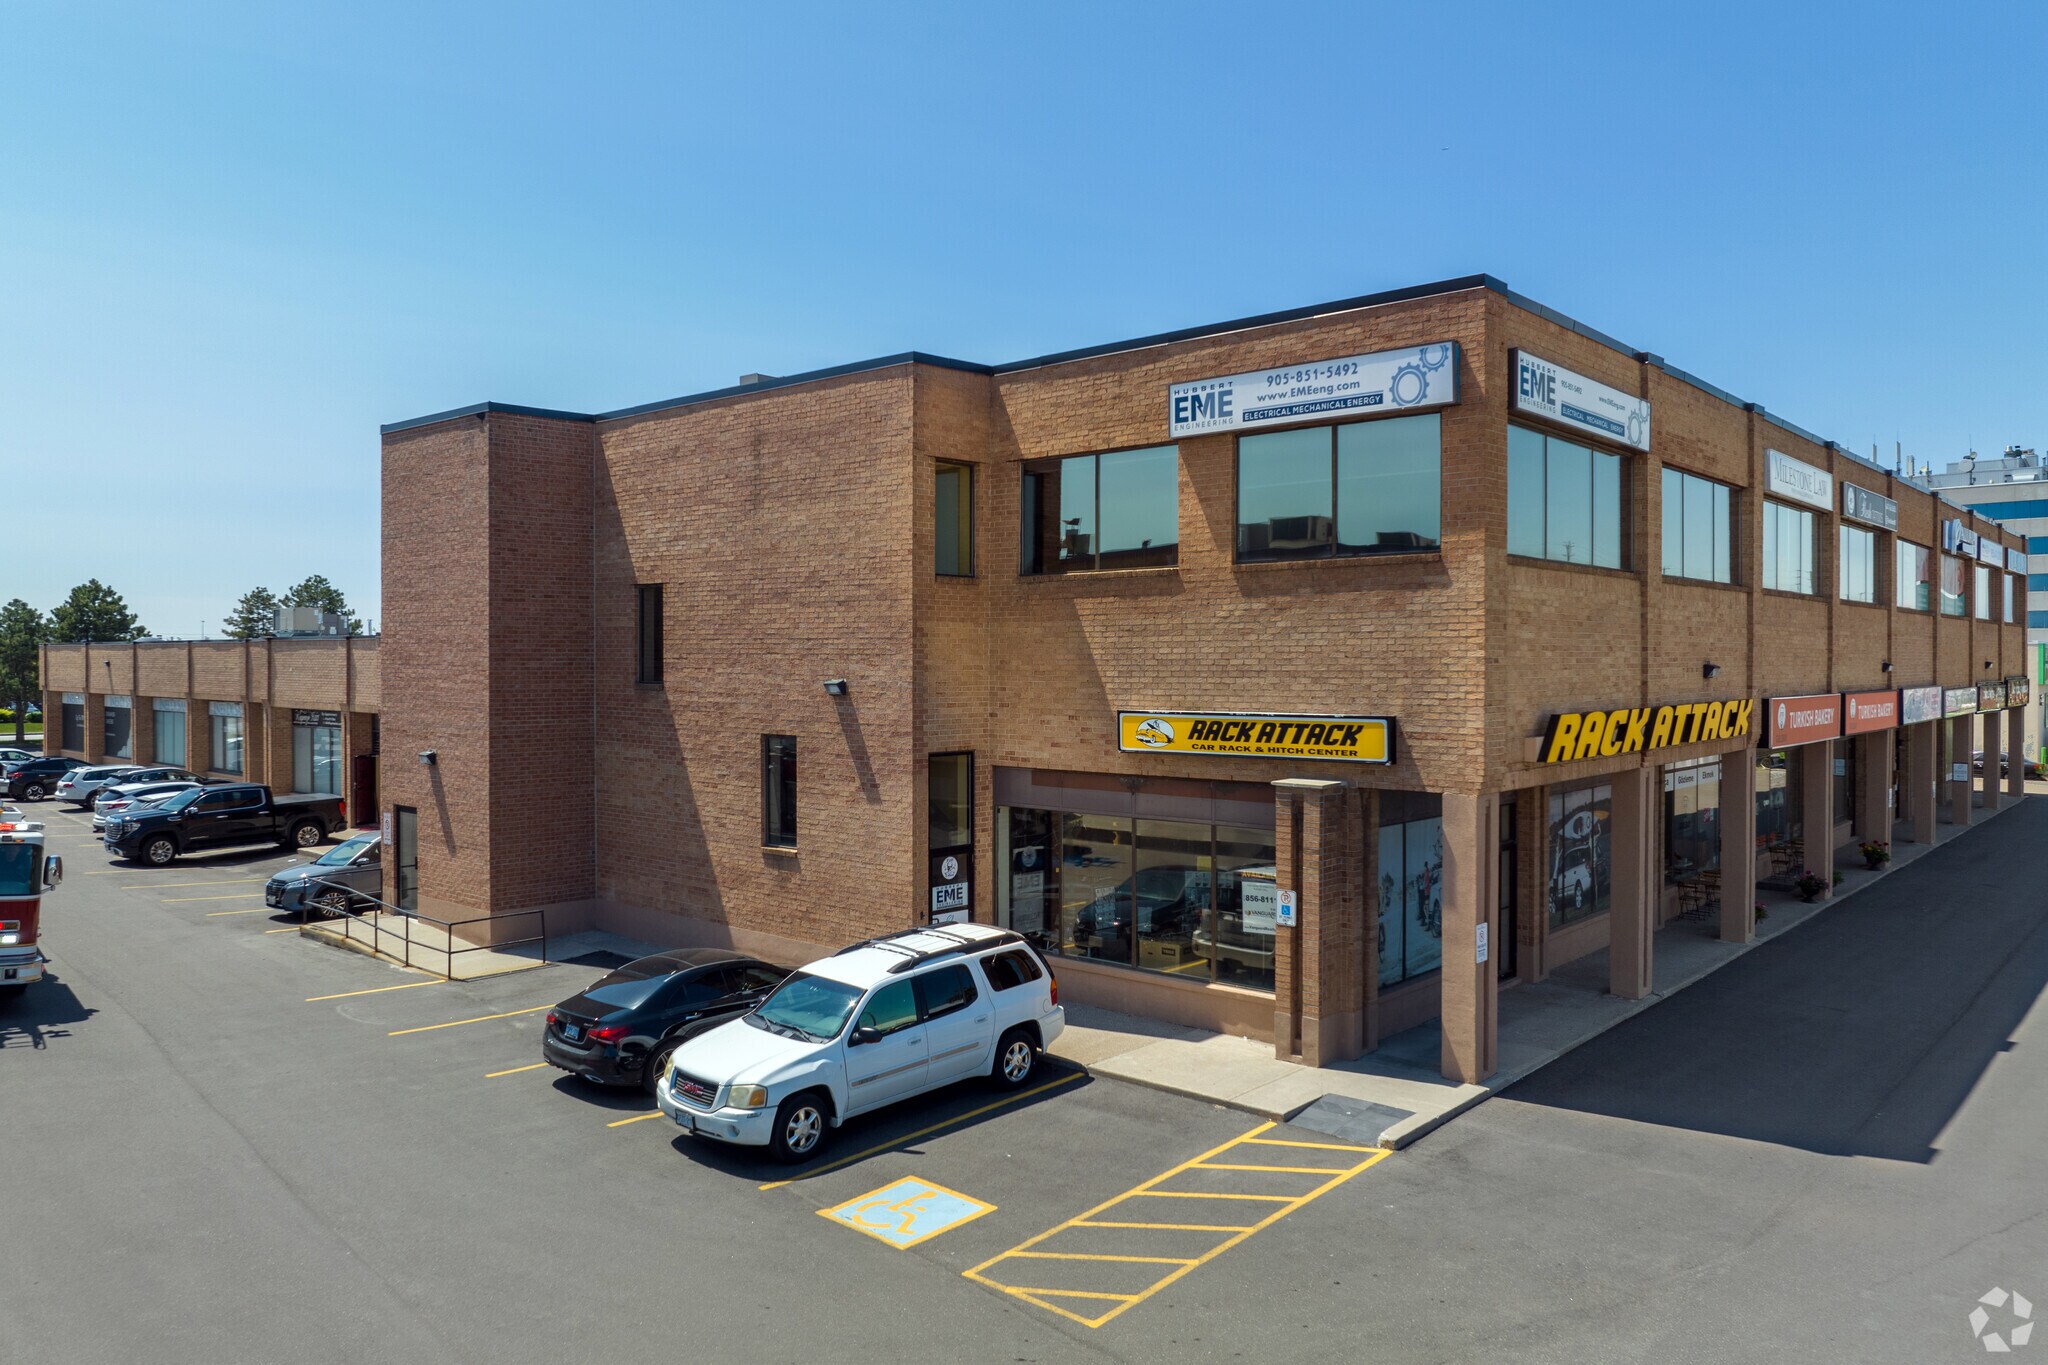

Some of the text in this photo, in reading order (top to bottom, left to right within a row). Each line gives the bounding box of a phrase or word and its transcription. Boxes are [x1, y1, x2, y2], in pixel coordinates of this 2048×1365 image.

[1266, 362, 1359, 387] 905-851-5492
[1520, 357, 1557, 376] HUBBERT
[1174, 381, 1235, 396] HUBBERT
[1256, 380, 1361, 402] www.EMEeng.com
[1520, 364, 1556, 406] EME
[1174, 389, 1234, 423] EME
[1244, 394, 1381, 421] ELECTRICAL MECHANICAL ENERGY
[1519, 395, 1556, 414] ENGINEERING
[1174, 417, 1235, 431] ENGINEERING
[1562, 406, 1585, 421] ELECTRICAL
[1586, 416, 1609, 430] MECHANICAL
[1774, 455, 1827, 497] MILESTONE LAW
[1789, 711, 1814, 729] TURKISH
[1814, 707, 1835, 726] BAKERY
[1857, 704, 1878, 720] TURKISH
[1877, 702, 1894, 717] BAKERY
[1188, 720, 1364, 747] RACK ATTACK
[1546, 698, 1754, 764] RACK ATTACK
[1267, 747, 1304, 755] HITCH
[1308, 749, 1358, 757] CENTER
[936, 887, 963, 904] EME
[1252, 909, 1276, 920] VANGUAR
